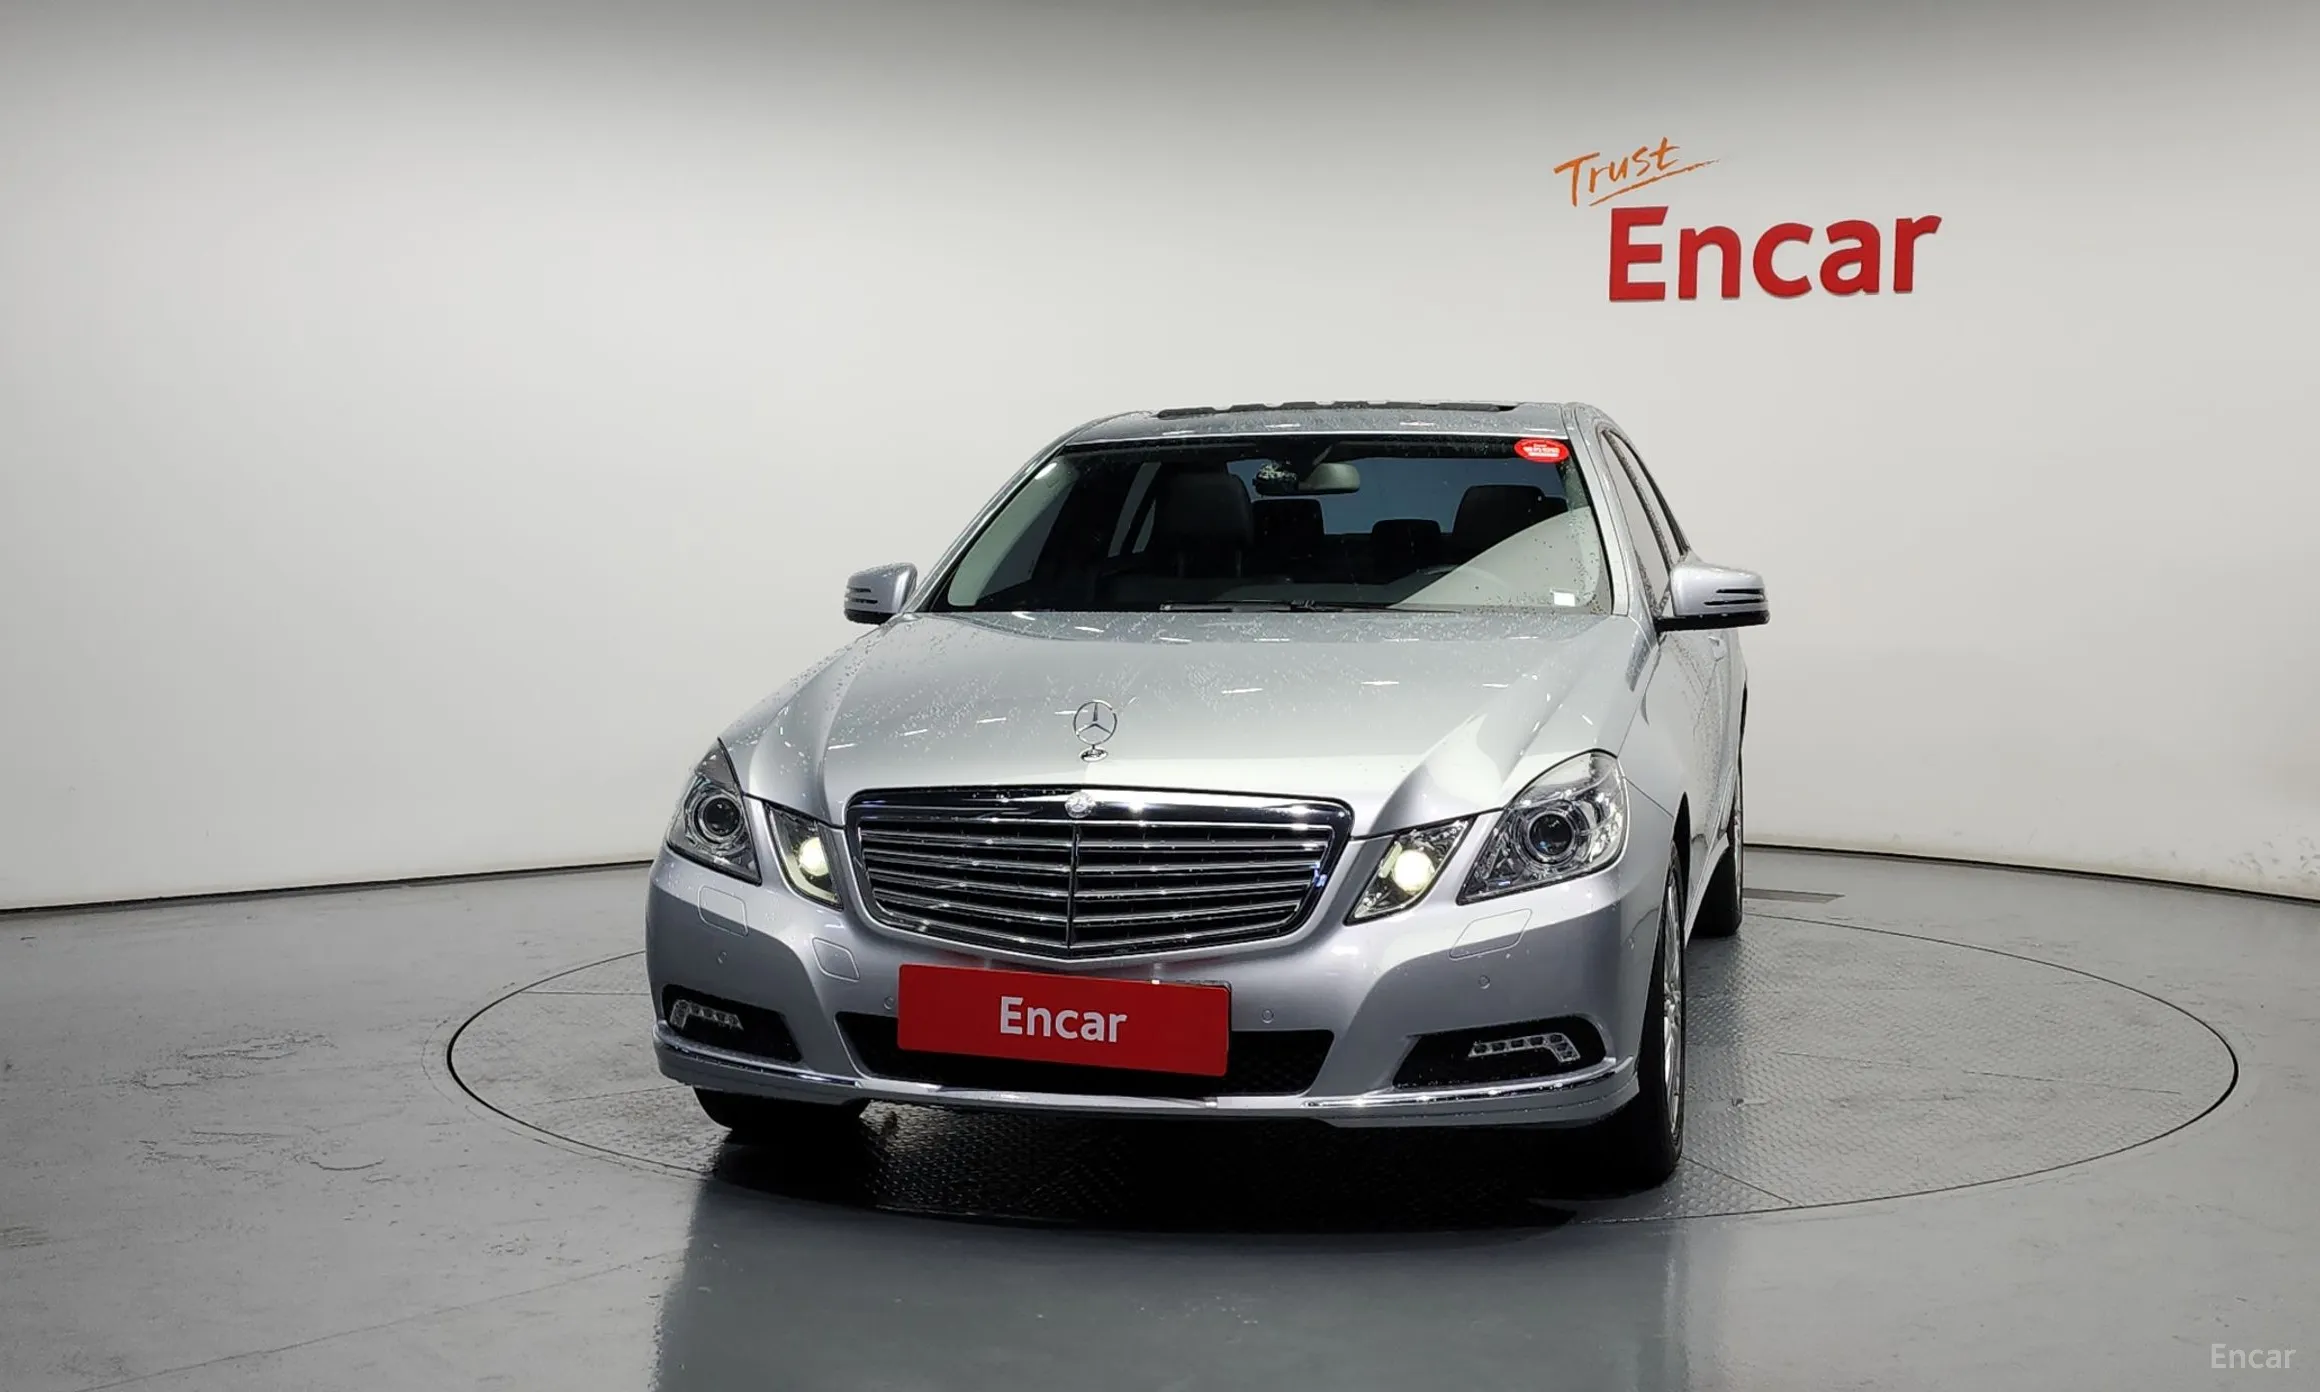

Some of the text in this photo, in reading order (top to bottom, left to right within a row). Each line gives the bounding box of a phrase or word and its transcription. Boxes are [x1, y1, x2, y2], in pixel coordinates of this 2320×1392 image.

[1554, 137, 1684, 206] Trust
[1609, 205, 1942, 302] Encar
[1000, 996, 1128, 1042] Encar
